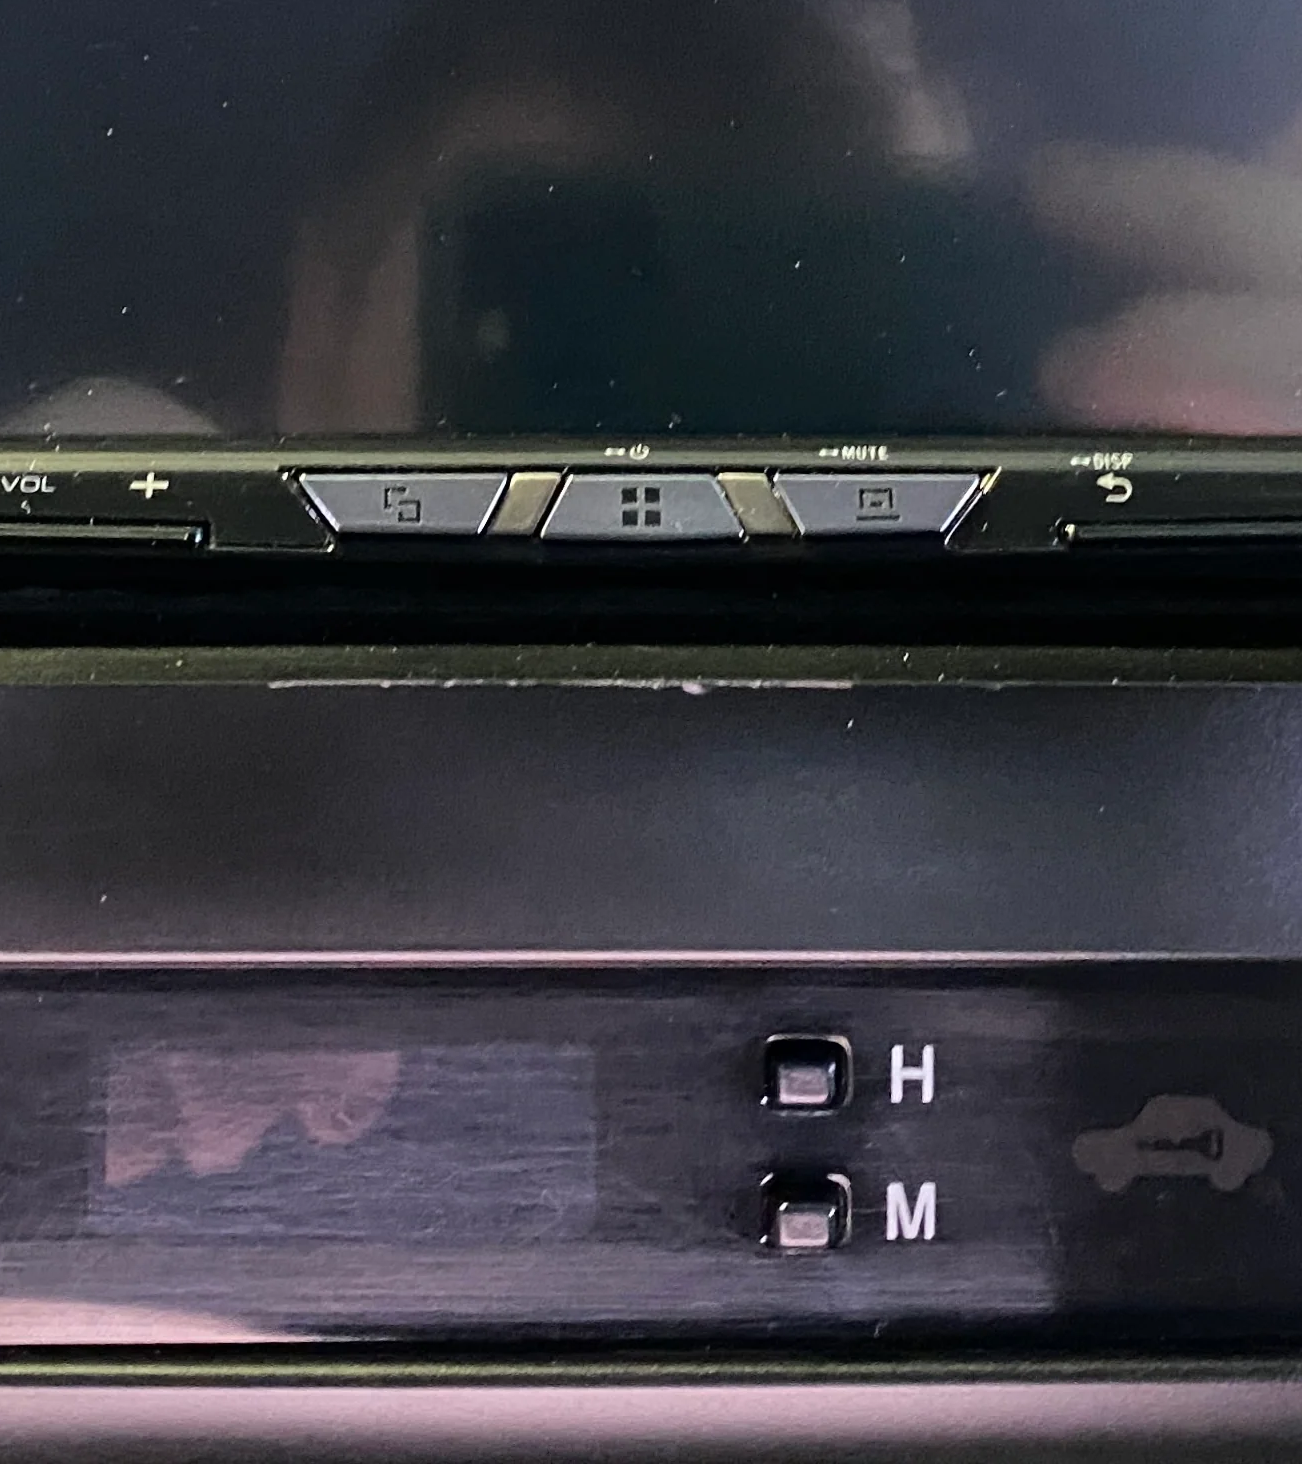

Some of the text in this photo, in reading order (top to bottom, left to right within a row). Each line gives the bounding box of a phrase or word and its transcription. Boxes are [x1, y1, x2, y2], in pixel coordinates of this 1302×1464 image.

[841, 445, 889, 461] MUTE
[1092, 452, 1133, 471] DISP
[1, 475, 55, 494] VOL
[890, 1044, 935, 1104] H
[885, 1181, 938, 1242] M
